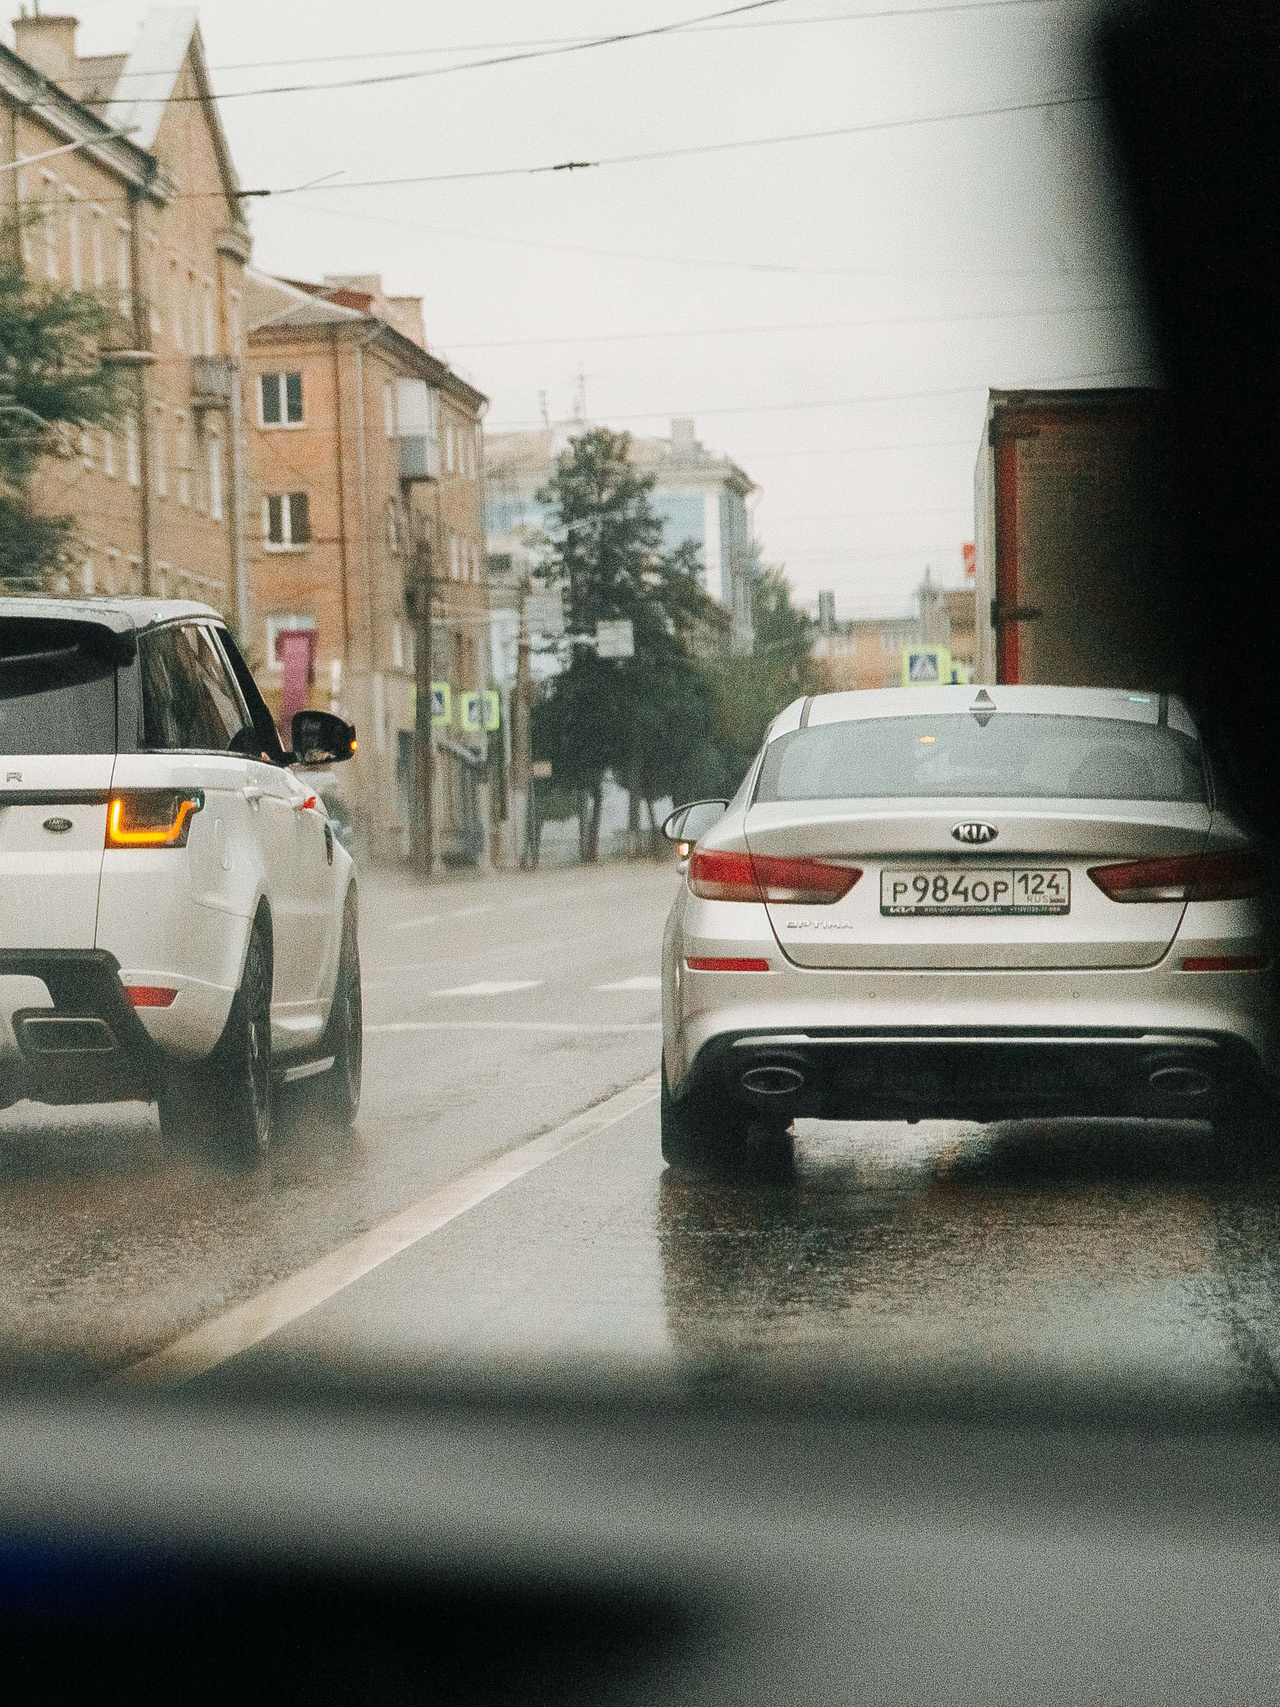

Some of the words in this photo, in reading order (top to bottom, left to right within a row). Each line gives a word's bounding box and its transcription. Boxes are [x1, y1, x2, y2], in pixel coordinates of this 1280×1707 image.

[958, 824, 991, 840] KIA
[1017, 873, 1061, 895] 124
[1026, 895, 1049, 904] RUS
[786, 920, 854, 930] OPTIMA
